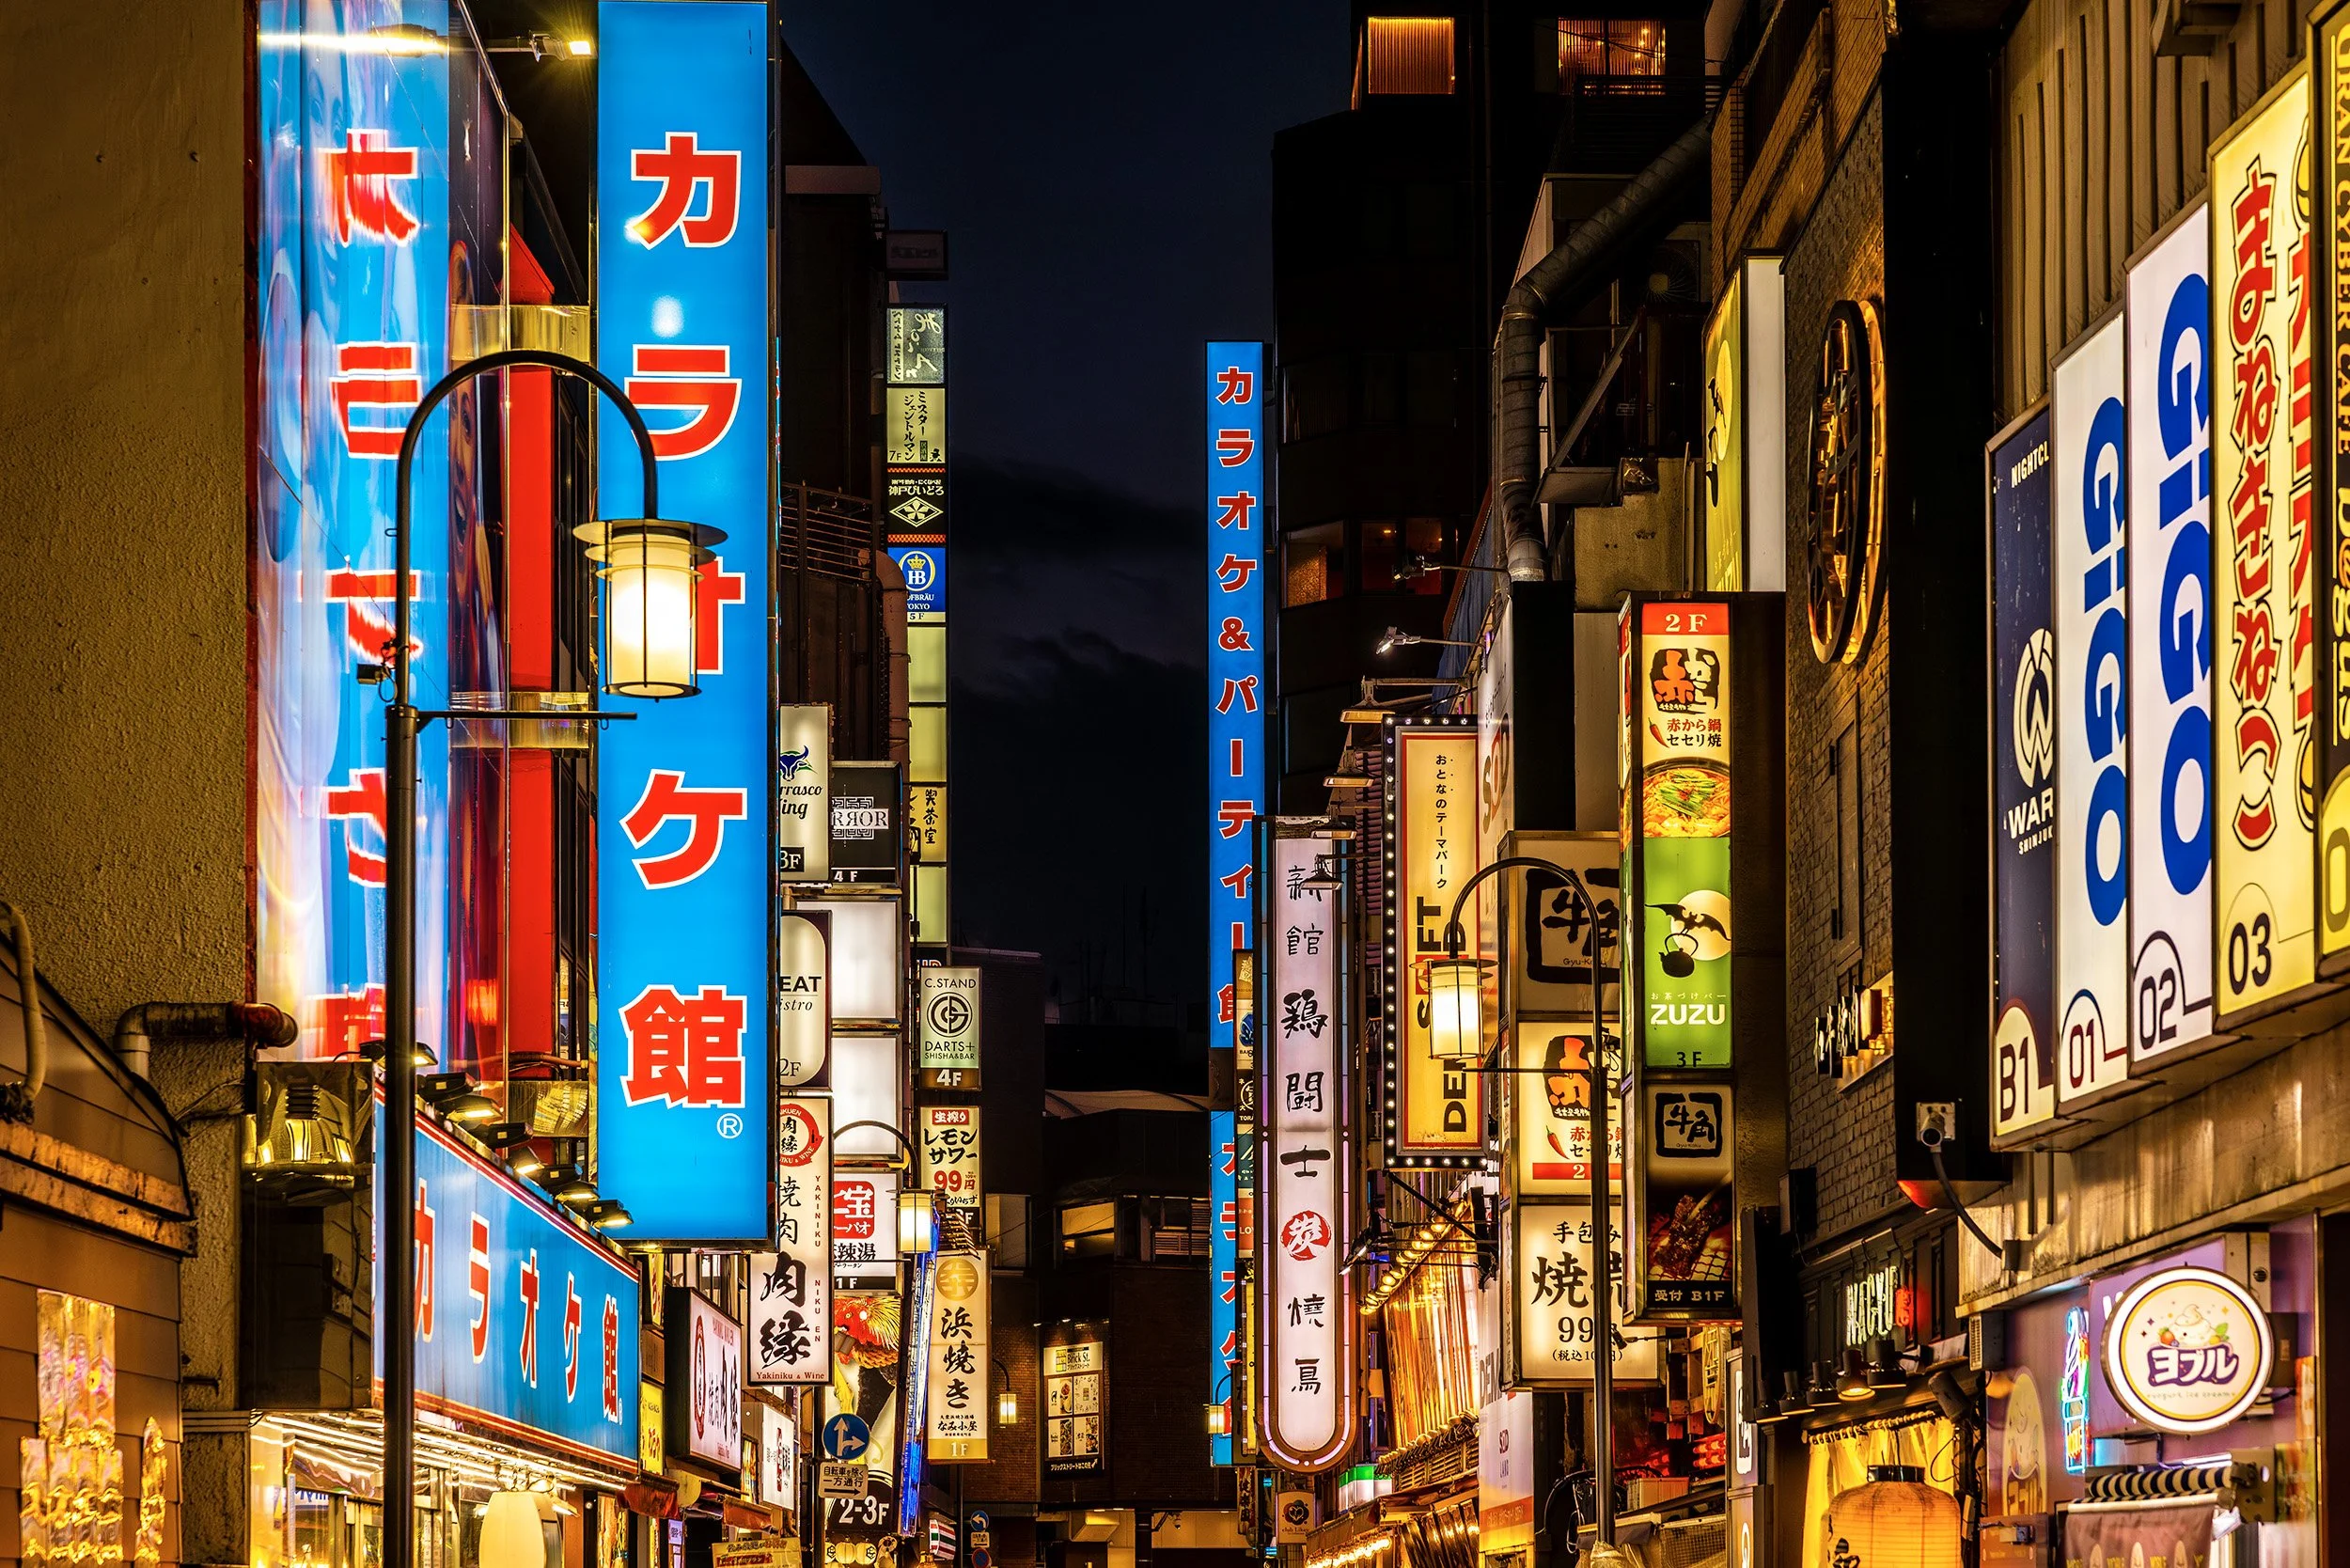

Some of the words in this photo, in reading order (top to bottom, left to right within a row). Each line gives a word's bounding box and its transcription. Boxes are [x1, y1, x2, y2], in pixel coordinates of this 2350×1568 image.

[917, 391, 928, 436] ミスター
[888, 450, 901, 461] 7F
[888, 486, 944, 495] 神戸びいどろ
[1667, 718, 1722, 732] 赤から鍋
[1667, 733, 1722, 747] セセリ焼
[780, 799, 808, 820] ing
[923, 789, 939, 845] 喫茶室
[1434, 754, 1447, 889] おとなのテーマパーク
[2229, 913, 2272, 996] 03
[925, 978, 977, 988] C.STAND
[1651, 992, 1726, 1000] お茶づけバー
[1651, 1004, 1725, 1026] ZUZU
[2139, 968, 2176, 1051] 02
[925, 1041, 976, 1052] DARTS+
[2069, 1018, 2095, 1089] 01
[924, 1052, 975, 1060] SHISHA&BAR
[936, 1068, 962, 1087] 4F
[1999, 1019, 2029, 1122] B1
[933, 1111, 966, 1123] 生搾り
[1665, 1104, 1716, 1143] 牛角
[924, 1128, 978, 1146] レモン
[929, 1146, 978, 1165] サワー
[836, 1278, 857, 1290] 1F
[1654, 1289, 1683, 1302] 受付
[1691, 1290, 1725, 1302] B1F
[760, 1250, 811, 1370] 肉縁
[941, 1307, 976, 1409] 浜焼き
[2152, 1348, 2238, 1383] ヨブル
[756, 1372, 792, 1380] Yakiniku
[804, 1372, 824, 1380] Wine
[951, 1441, 969, 1457] 1F
[823, 1466, 863, 1477] 自転車を除く
[822, 1477, 863, 1487] 一方通行
[838, 1495, 889, 1525] 2-3F
